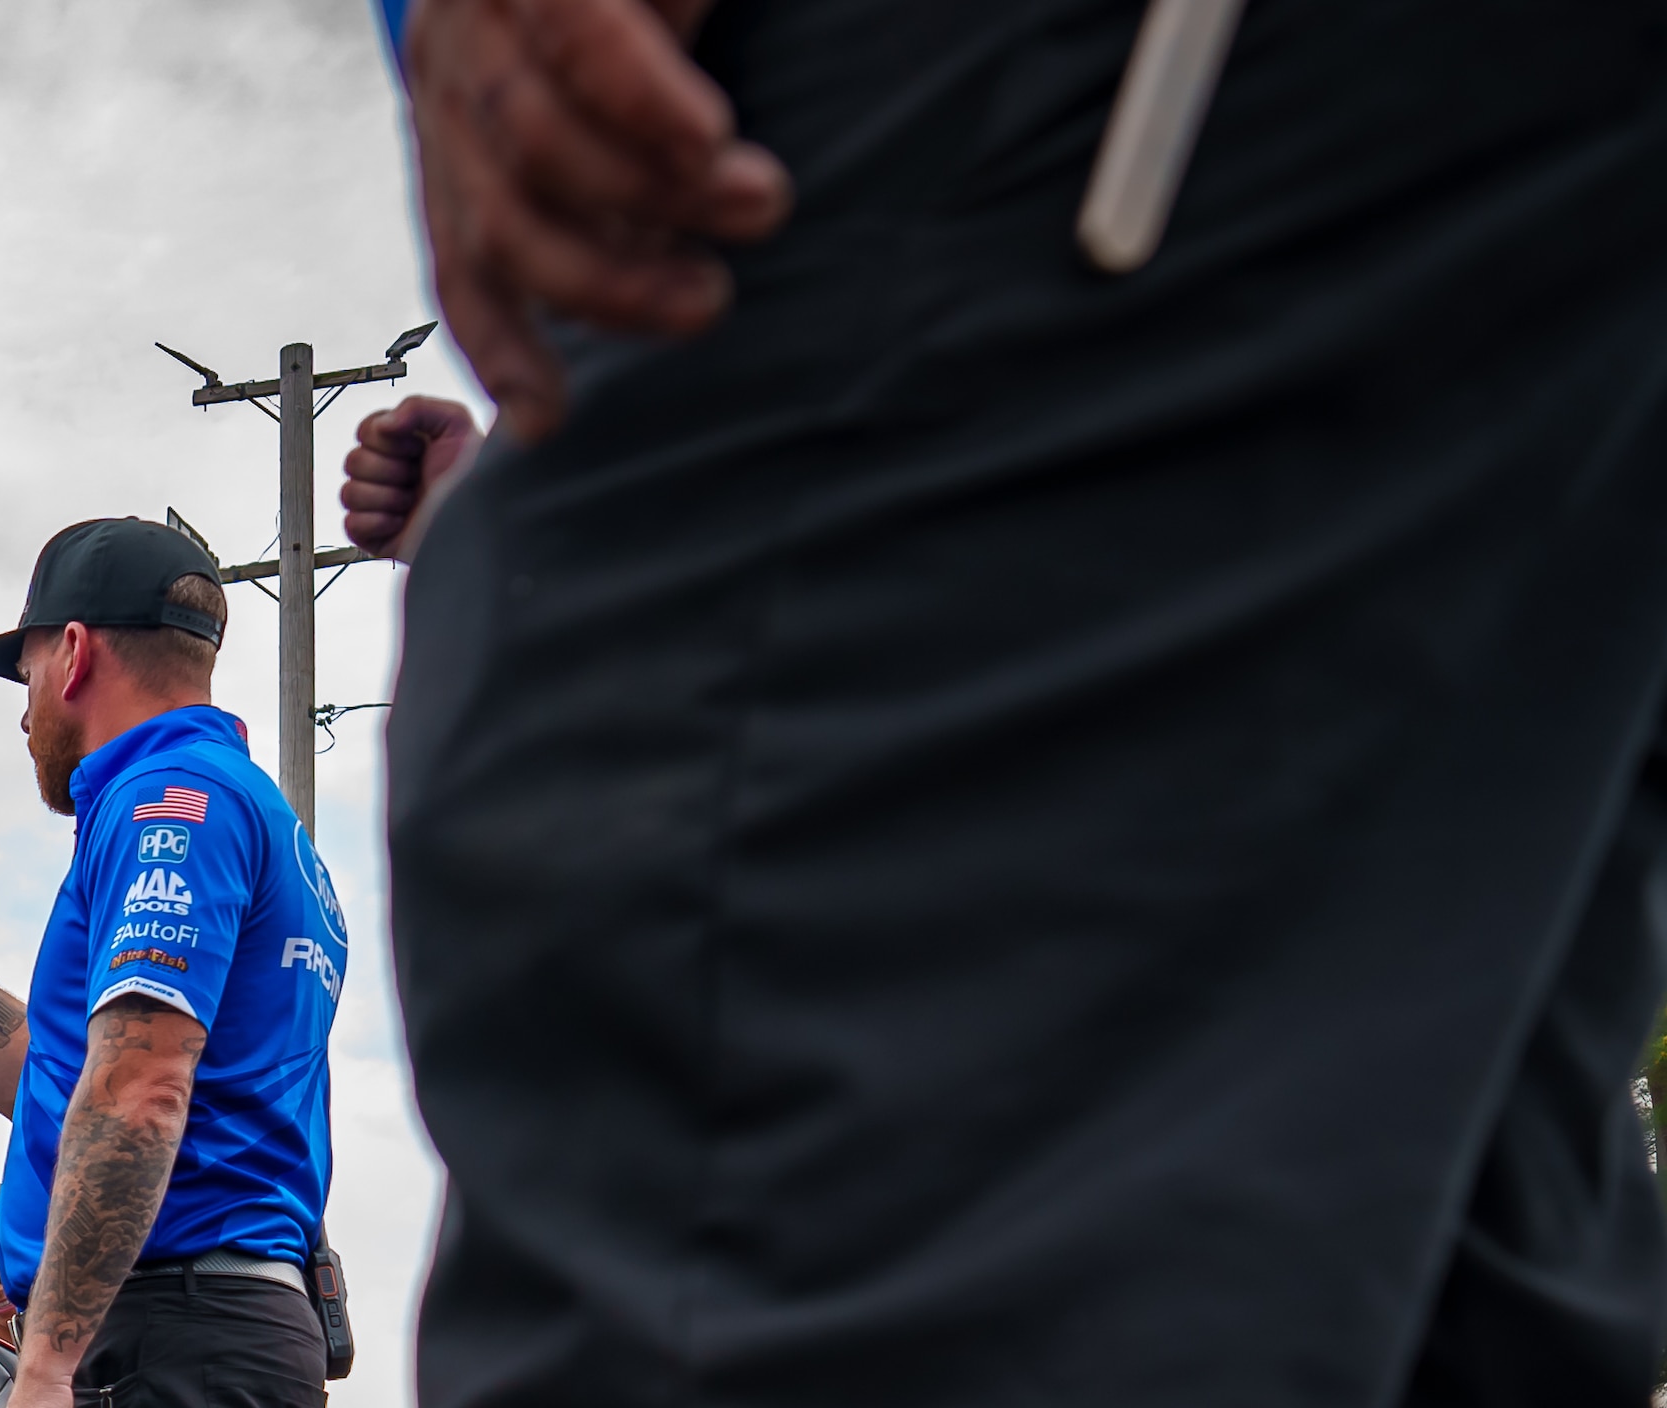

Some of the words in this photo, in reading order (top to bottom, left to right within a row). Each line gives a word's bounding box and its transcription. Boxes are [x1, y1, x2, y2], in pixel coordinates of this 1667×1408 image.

[141, 828, 187, 857] PPG
[124, 868, 192, 906] MAC
[123, 901, 189, 917] TOOLS
[122, 920, 200, 948] AutoFi
[149, 948, 189, 972] Fish
